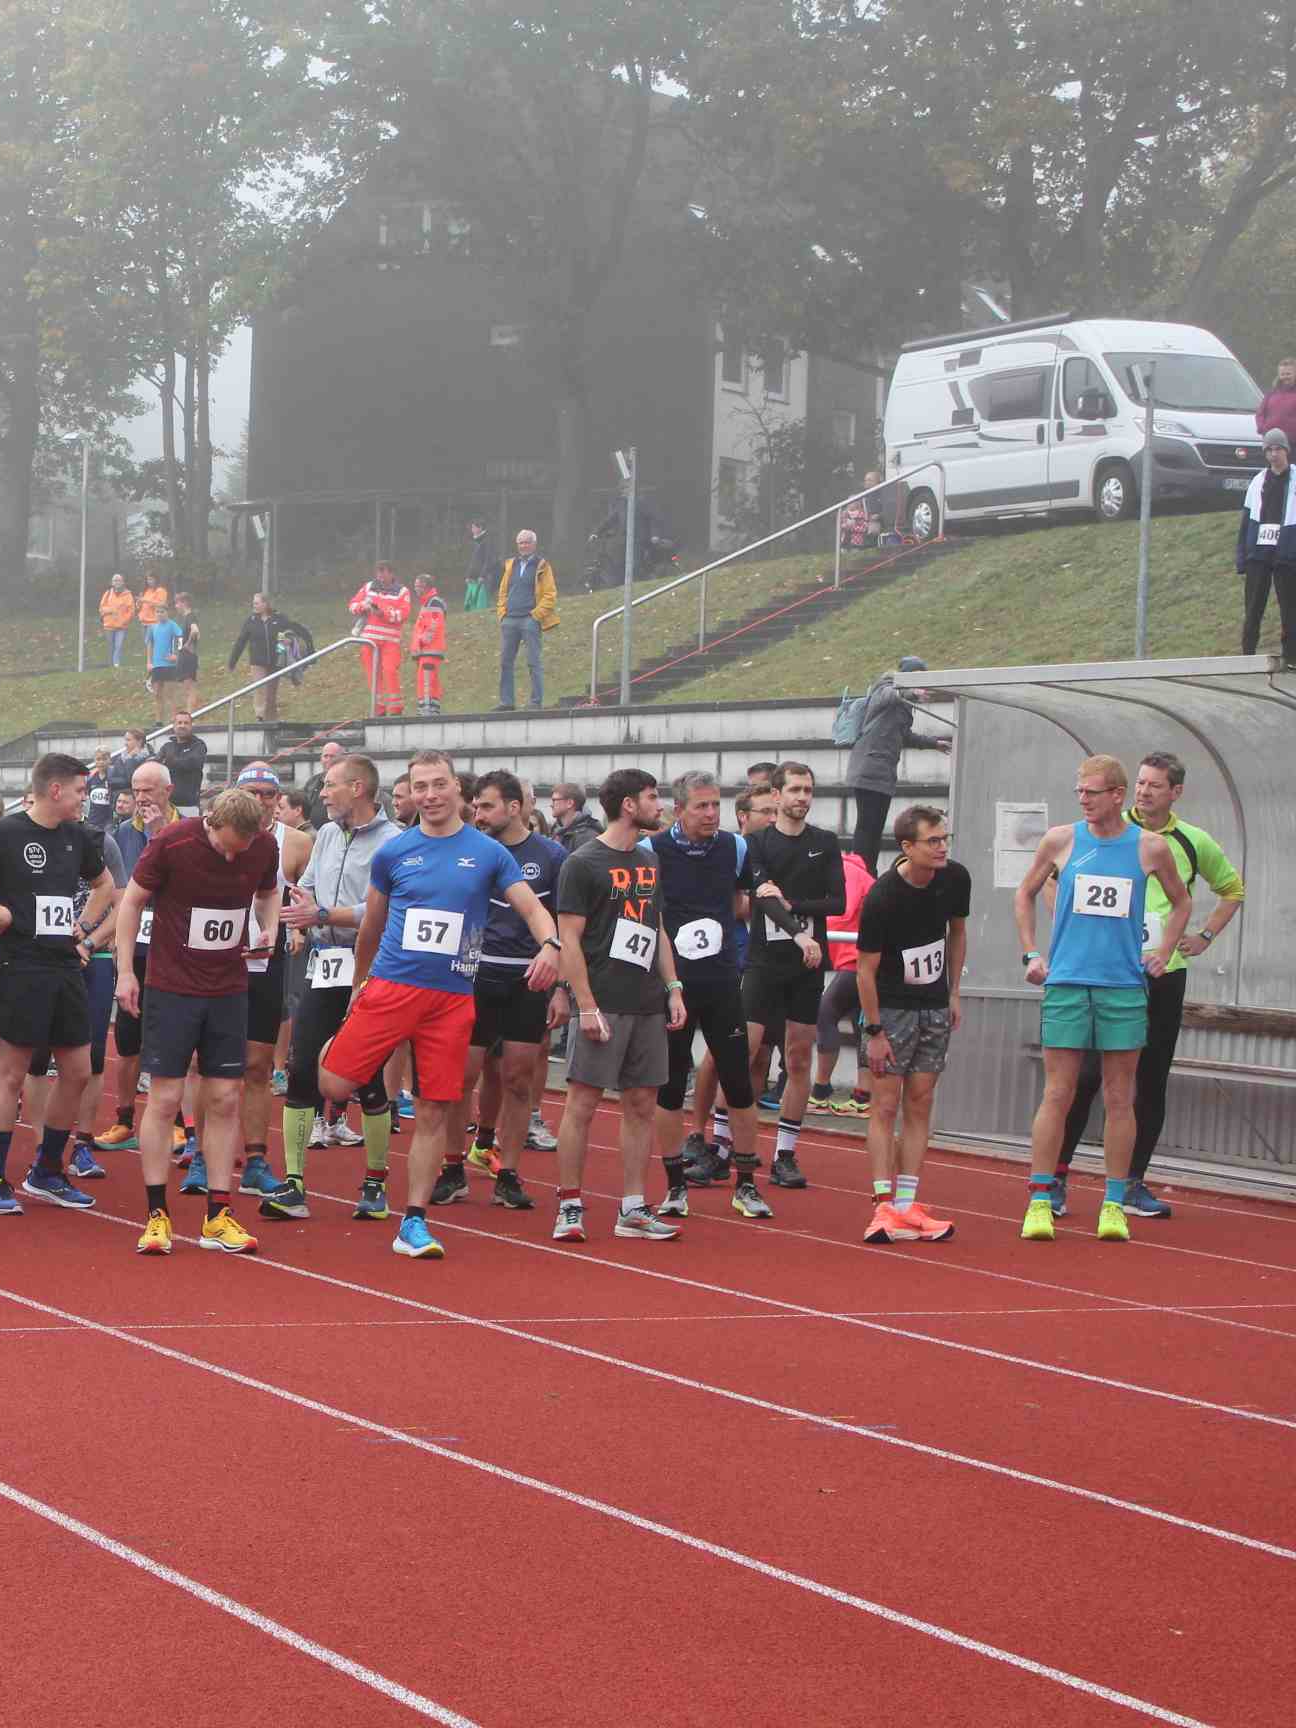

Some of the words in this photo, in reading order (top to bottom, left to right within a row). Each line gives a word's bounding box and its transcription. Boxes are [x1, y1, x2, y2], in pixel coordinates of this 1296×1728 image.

[1086, 885, 1118, 908] 28
[42, 905, 73, 927] 124
[204, 919, 234, 941] 60
[417, 920, 449, 944] 57
[694, 929, 710, 949] 3
[625, 933, 651, 957] 47
[322, 958, 343, 980] 97
[910, 951, 942, 978] 113
